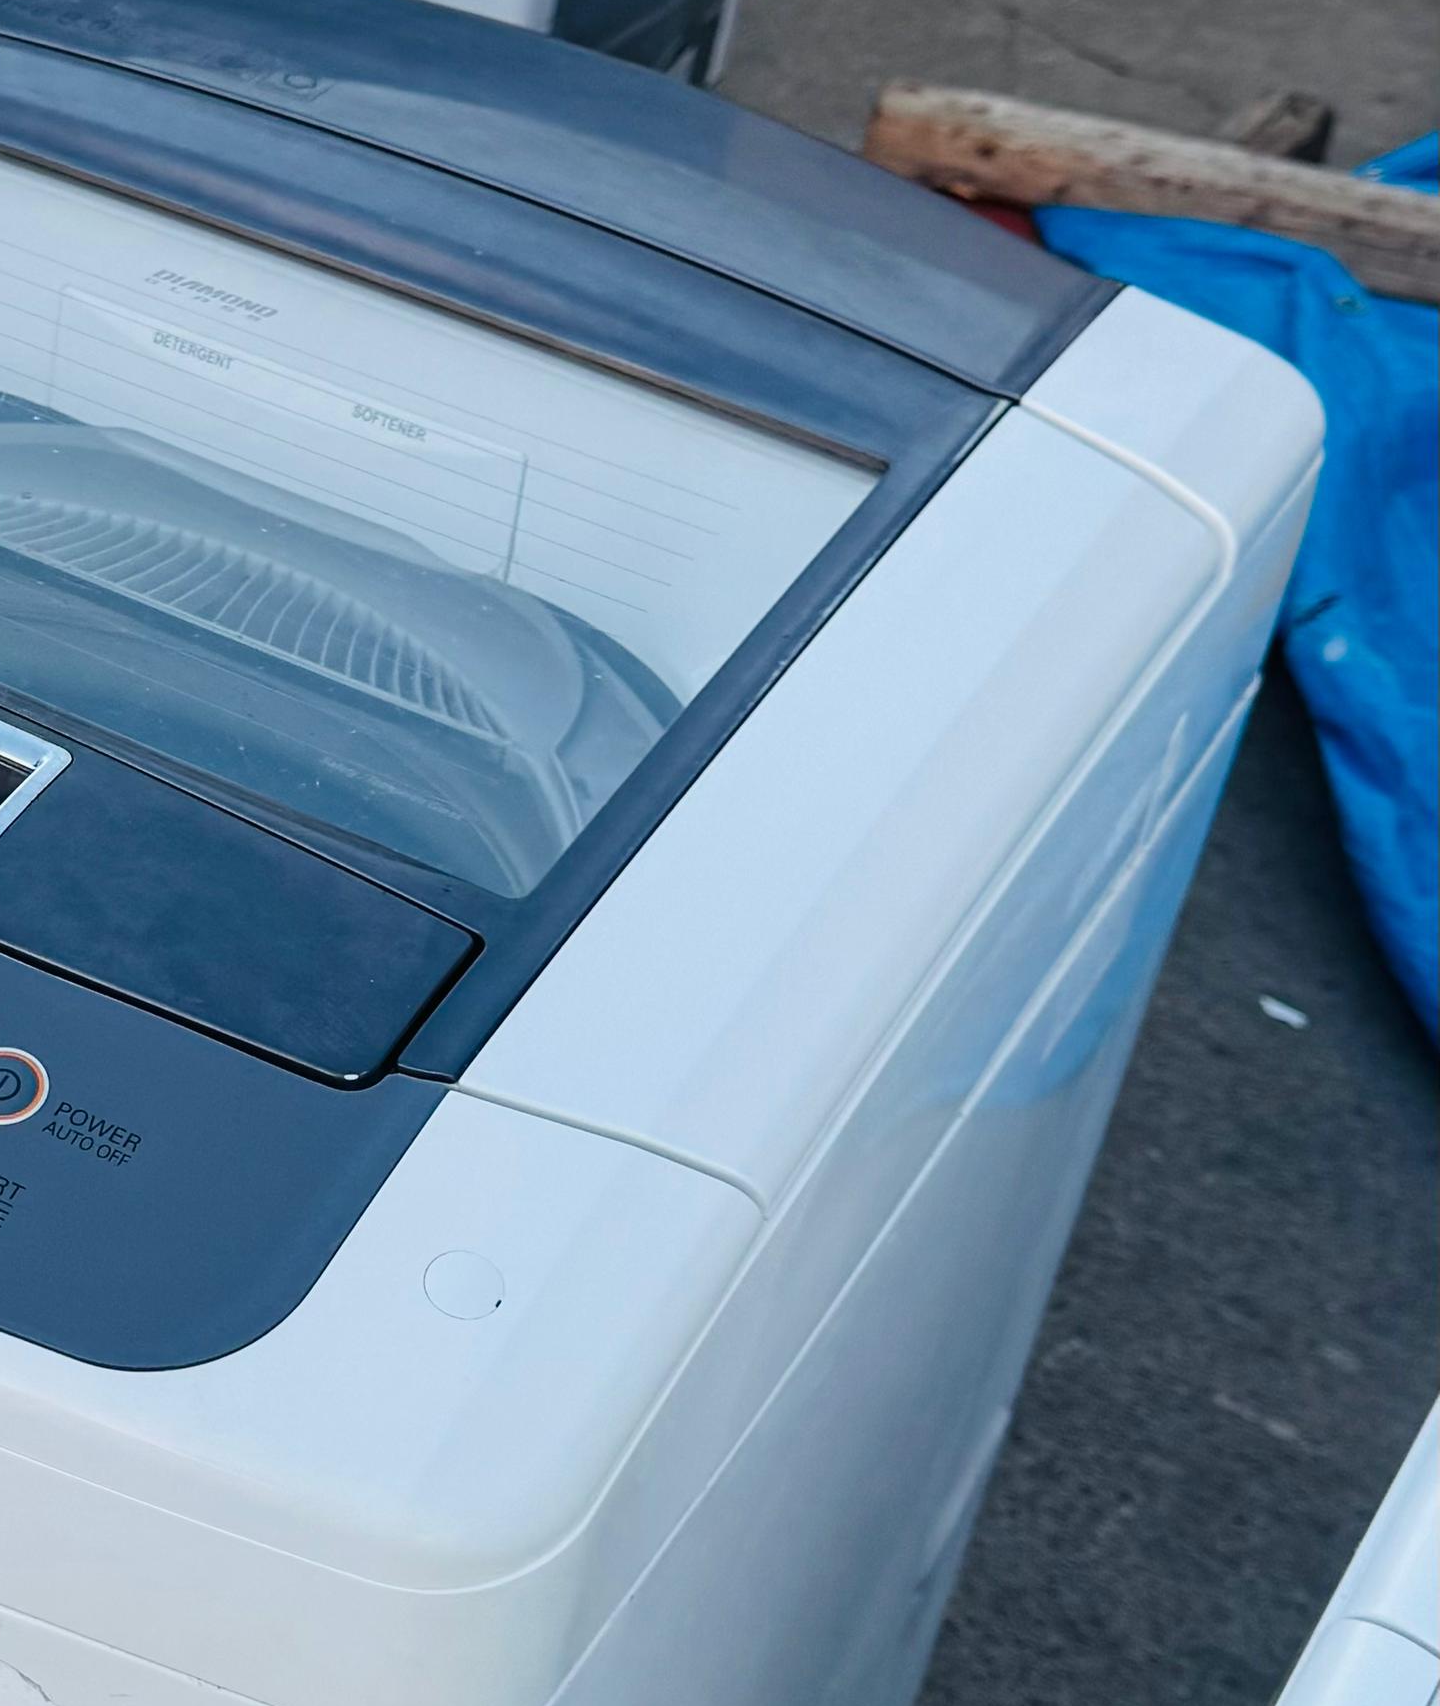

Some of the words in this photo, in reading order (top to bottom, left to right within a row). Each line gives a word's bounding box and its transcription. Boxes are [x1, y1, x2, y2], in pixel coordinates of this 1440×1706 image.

[153, 331, 234, 370] DETERGENT
[352, 405, 427, 442] SOFTENER
[42, 1121, 95, 1151] AUTO
[96, 1144, 133, 1167] OFF
[54, 1102, 142, 1153] POWER
